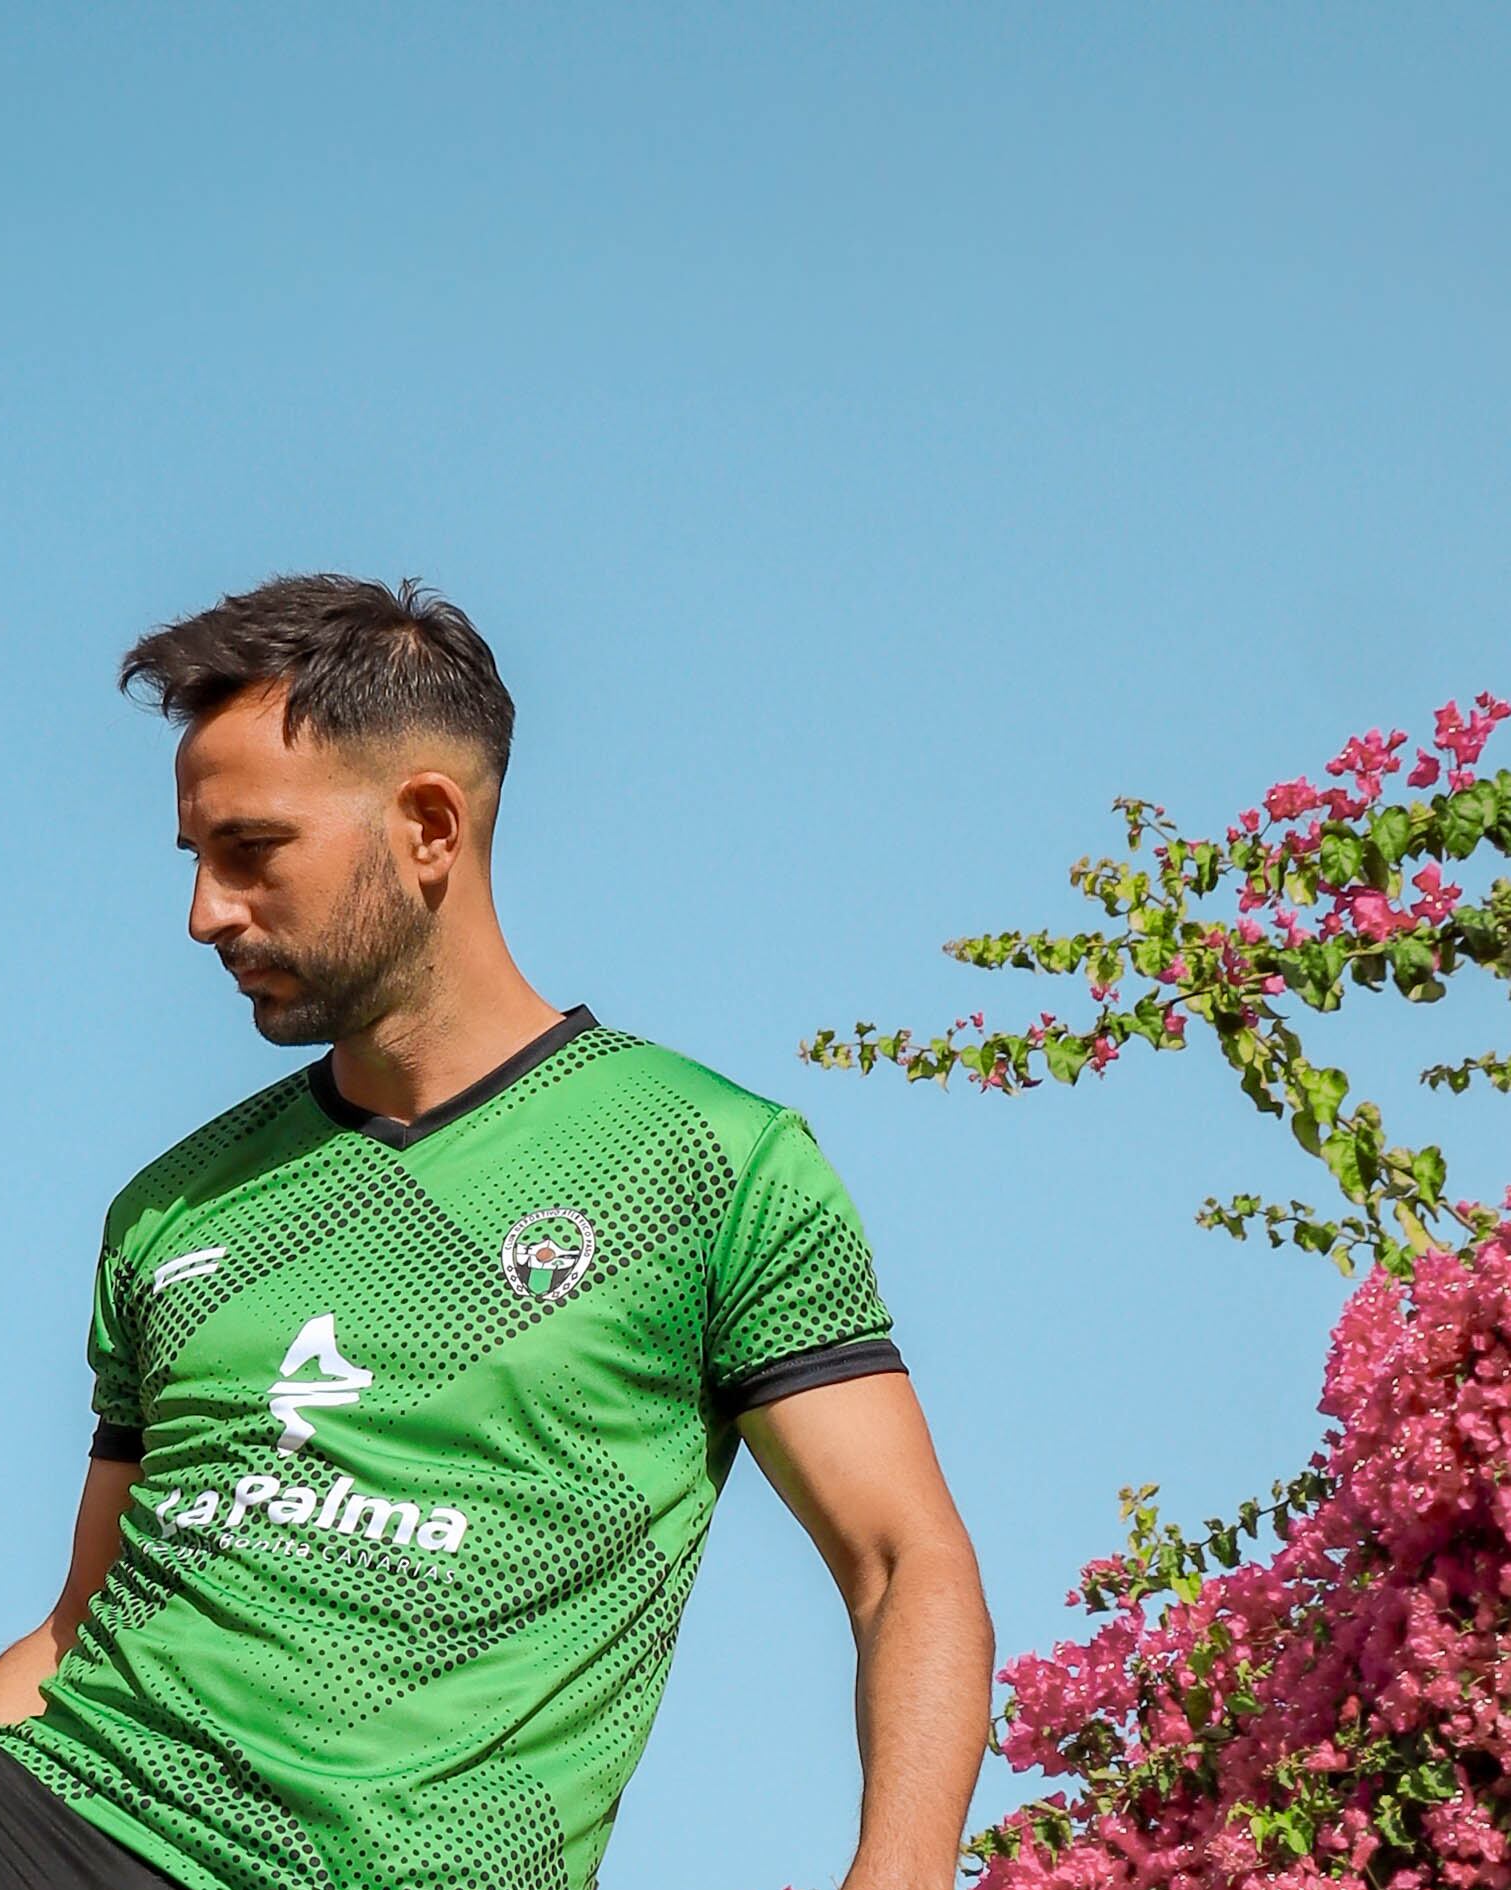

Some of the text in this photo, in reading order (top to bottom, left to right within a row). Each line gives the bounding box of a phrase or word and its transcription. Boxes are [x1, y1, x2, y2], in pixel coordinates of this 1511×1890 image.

[225, 1474, 467, 1553] Palma
[219, 1532, 311, 1558] Bonita
[322, 1546, 456, 1585] CANARIAS
